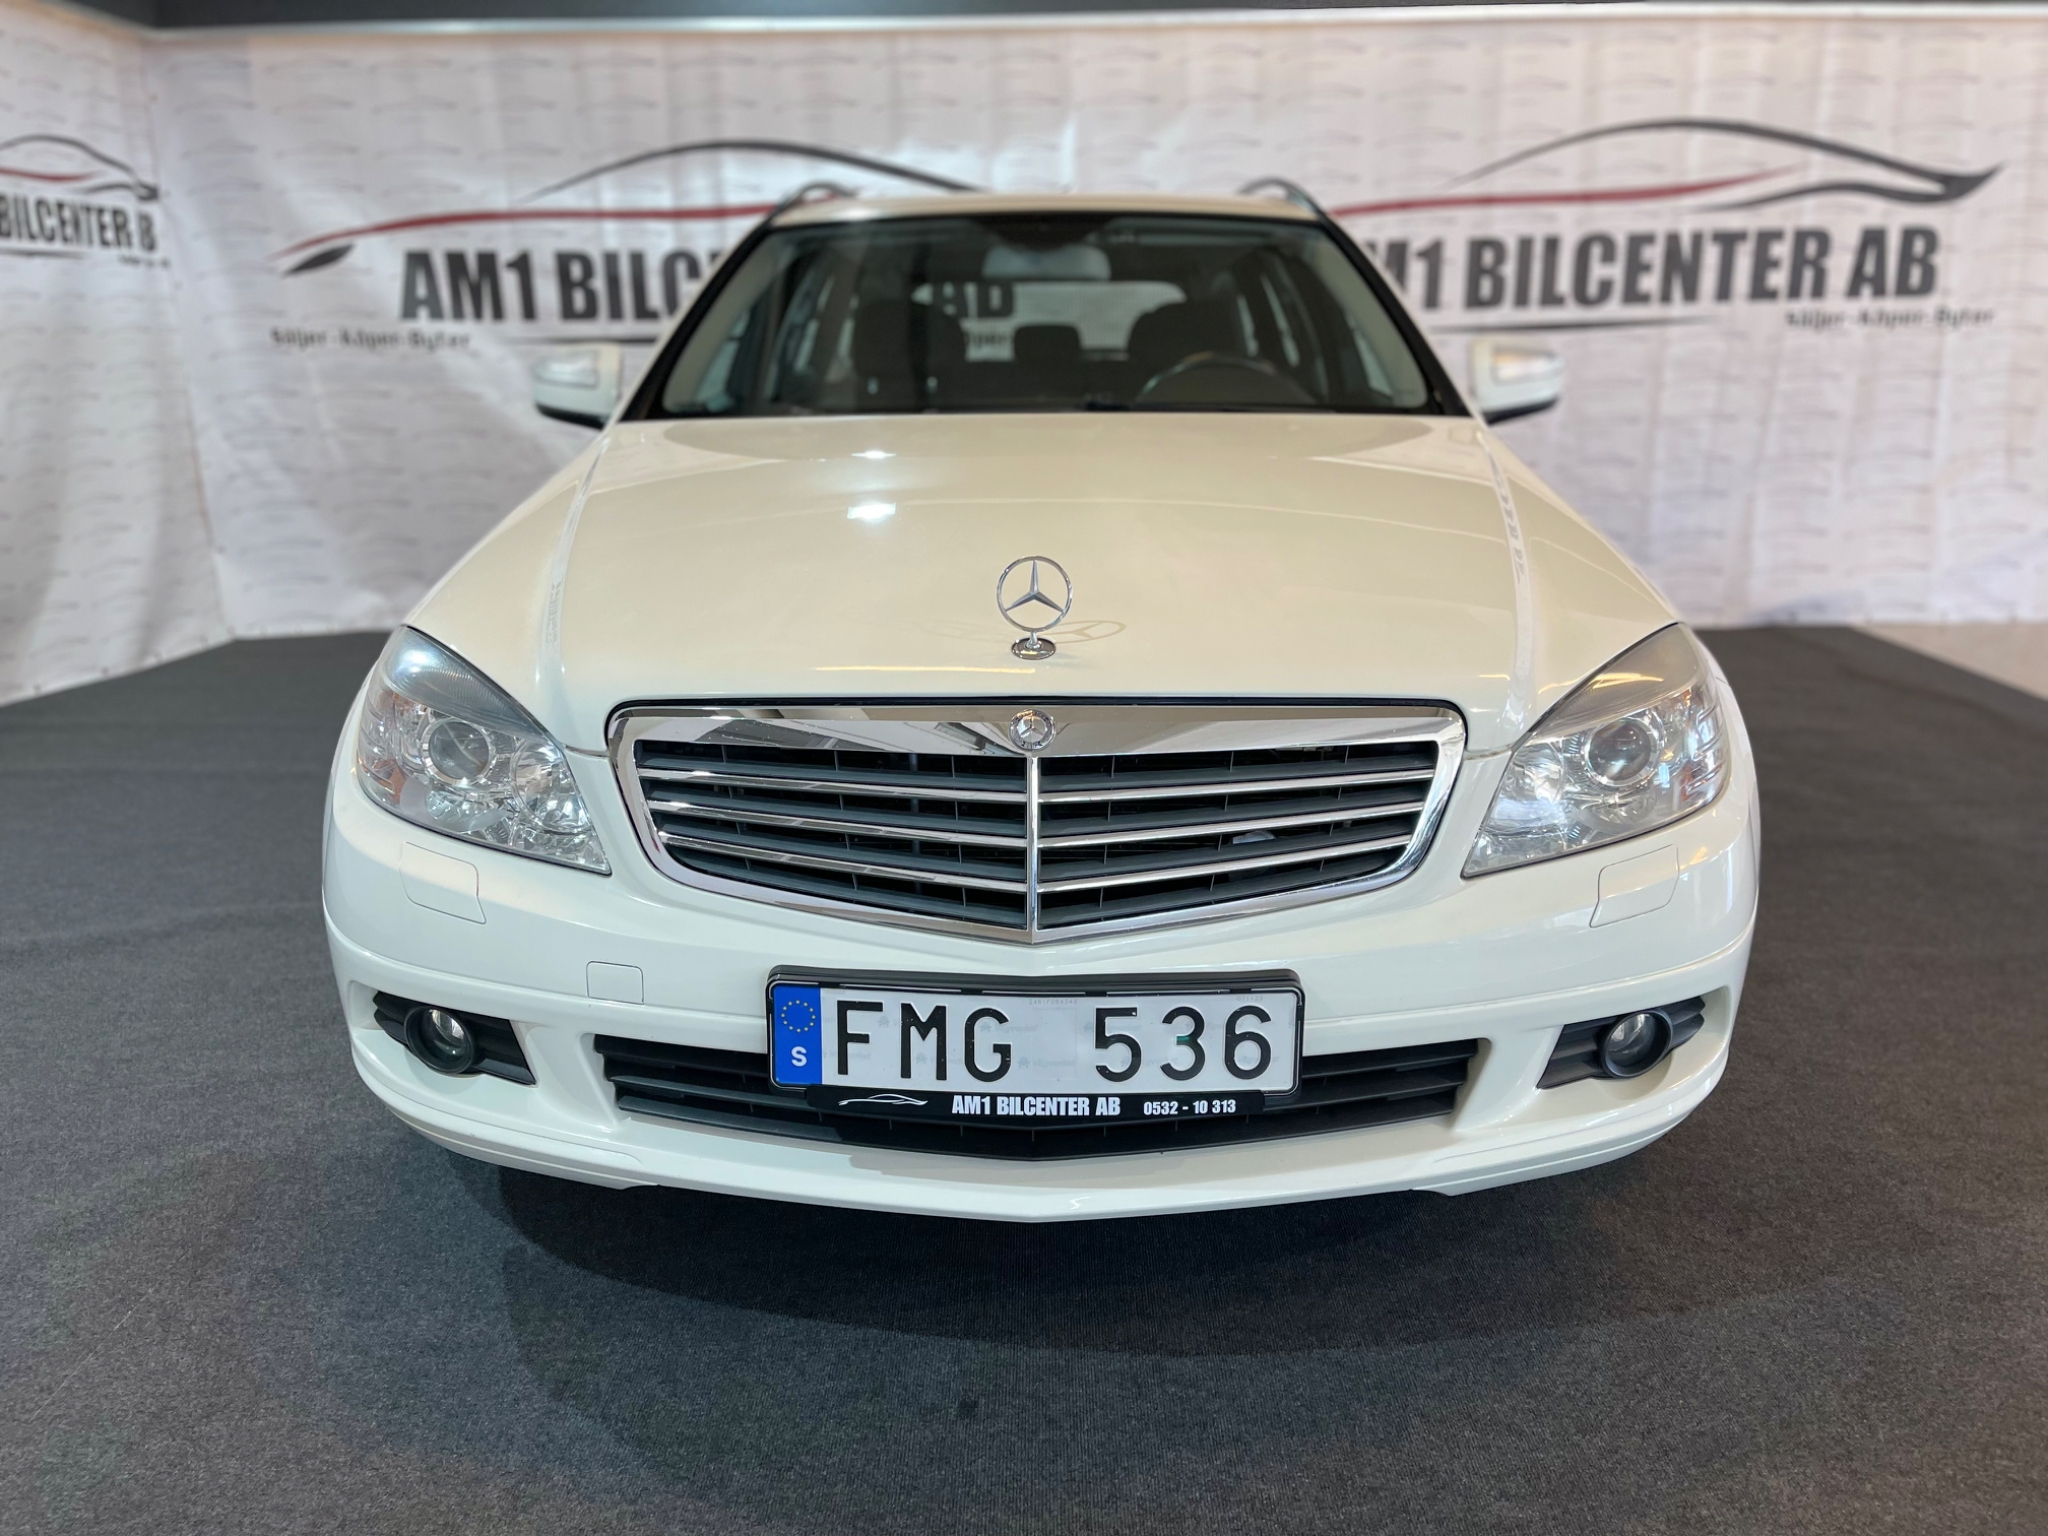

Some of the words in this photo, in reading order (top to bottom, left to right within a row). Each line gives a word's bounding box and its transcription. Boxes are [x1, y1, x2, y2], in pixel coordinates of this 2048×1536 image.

[400, 249, 537, 321] AM1
[1465, 228, 1831, 309] BILCENTER
[1847, 226, 1940, 299] AB
[791, 1047, 807, 1067] S
[837, 1000, 1012, 1083] FMG
[1094, 1005, 1271, 1083] 536
[952, 1095, 991, 1115] AM1
[997, 1096, 1089, 1116] BILCENTER
[1096, 1097, 1121, 1115] AB
[1143, 1101, 1178, 1115] 0532
[1193, 1100, 1208, 1114] 10
[1213, 1099, 1236, 1113] 313
